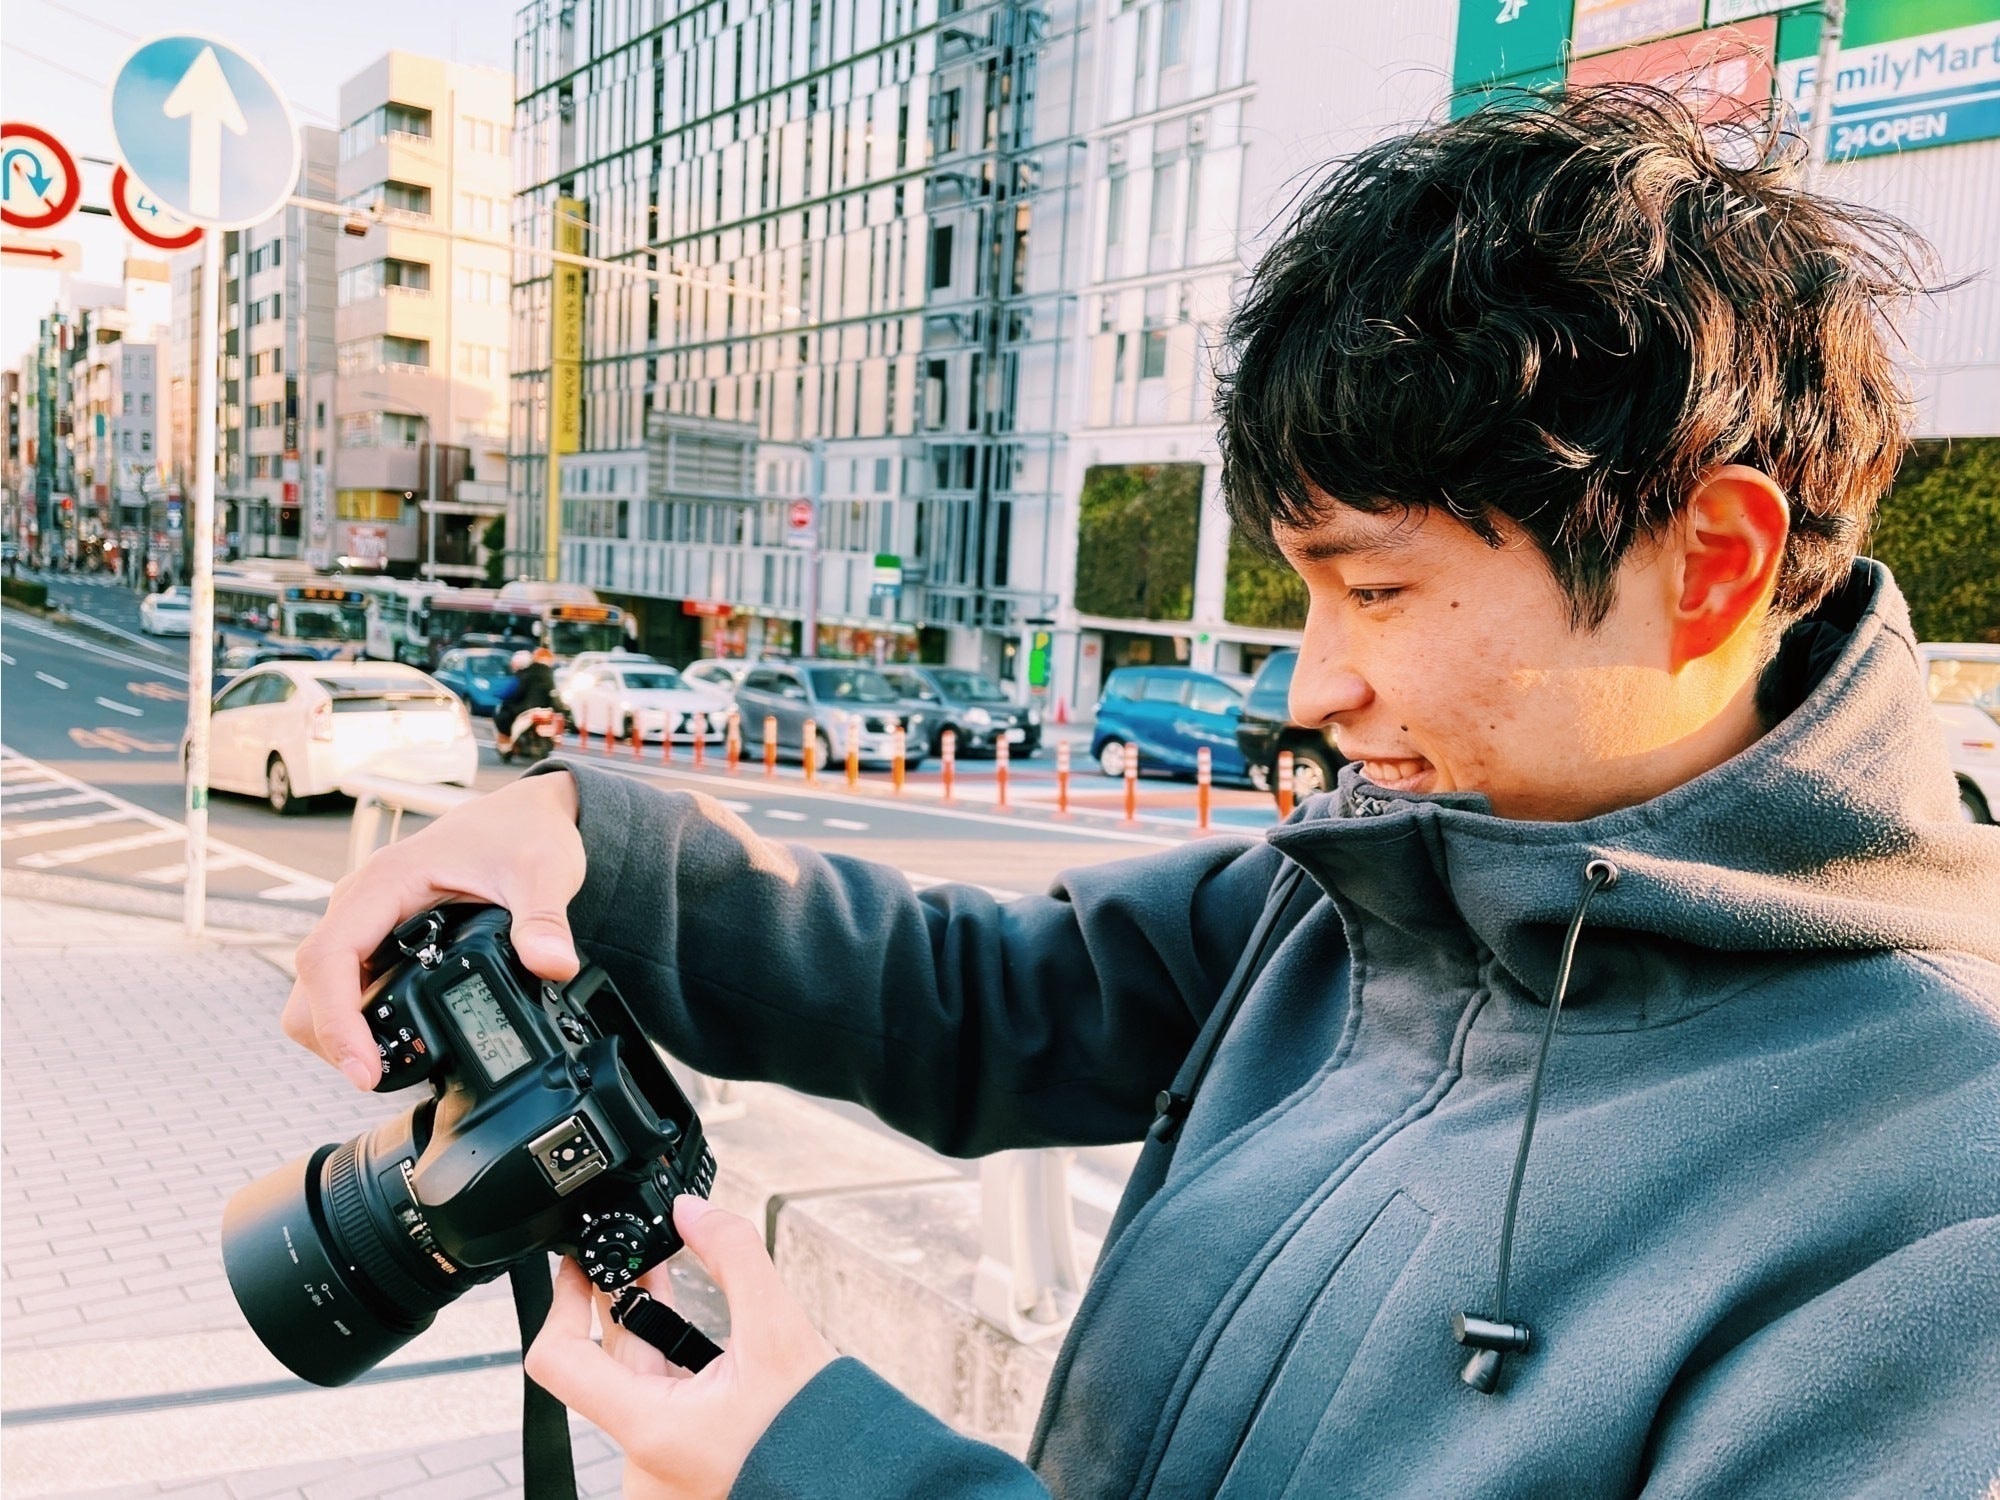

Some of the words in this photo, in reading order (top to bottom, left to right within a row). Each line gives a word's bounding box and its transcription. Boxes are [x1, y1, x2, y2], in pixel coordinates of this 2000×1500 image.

[1795, 34, 2000, 98] FmilyMart
[399, 1028, 411, 1042] ISO
[597, 1234, 607, 1243] A
[630, 1240, 638, 1250] P
[585, 1250, 596, 1259] M
[432, 1252, 458, 1275] Nikon
